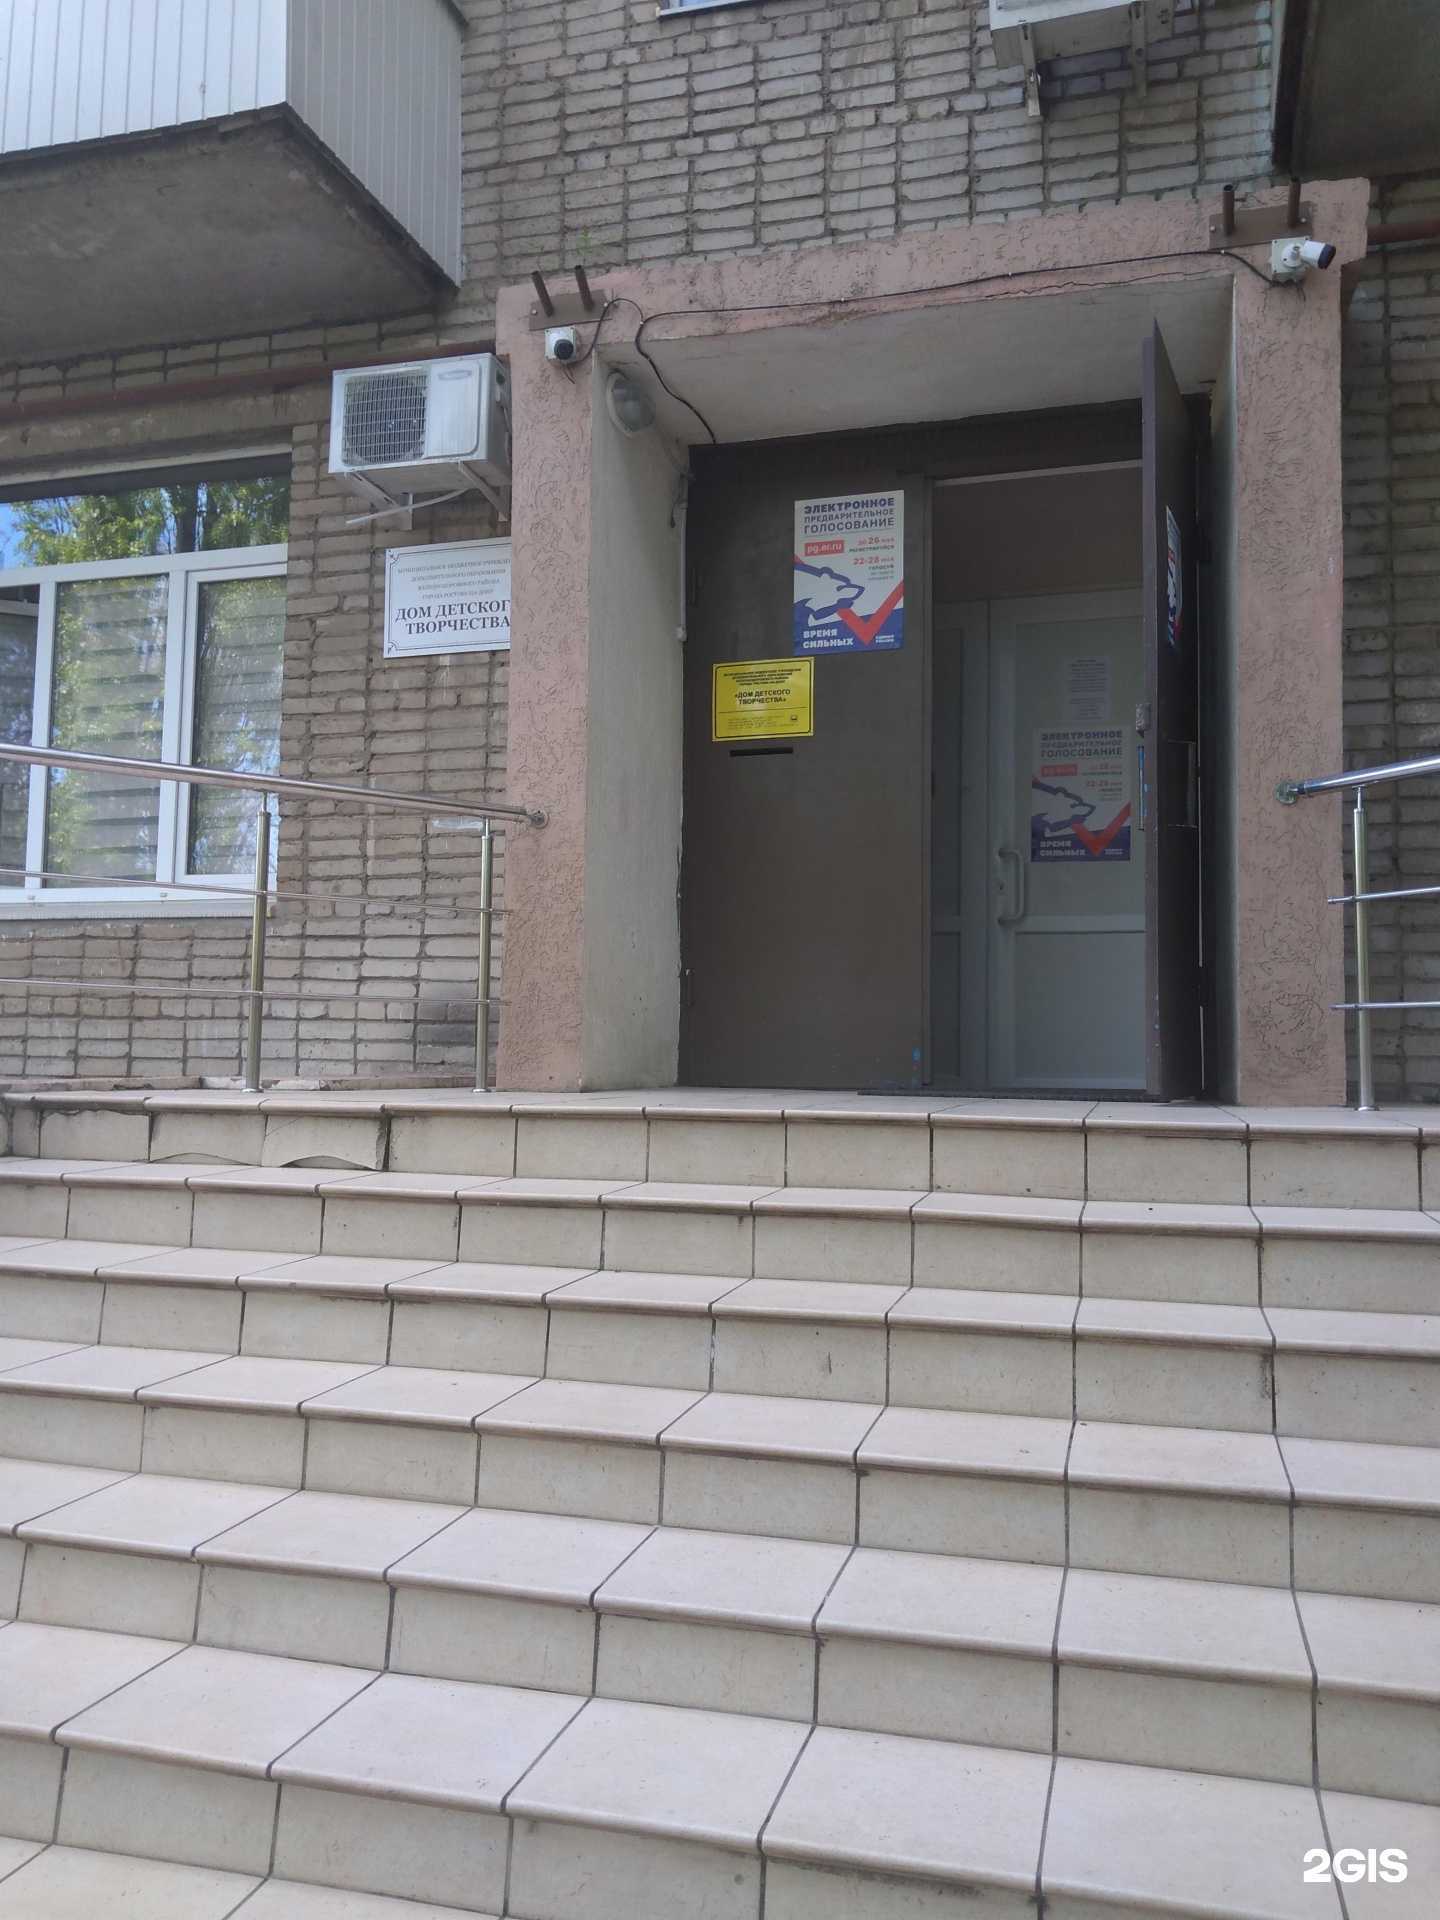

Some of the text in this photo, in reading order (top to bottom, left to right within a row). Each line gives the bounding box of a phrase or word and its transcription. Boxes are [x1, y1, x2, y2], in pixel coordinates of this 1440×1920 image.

[804, 497, 895, 515] ЭЛЕКТРОННОЕ
[804, 508, 894, 524] ПРЕДВАРИТЕЛЬНОЕ
[804, 517, 895, 534] ГОЛОСОВАНИЕ
[395, 600, 511, 623] ДОМ ДЕТСКОГ
[405, 615, 511, 635] ТВОРЧЕСТВА
[803, 629, 838, 639] ВРЕМЯ
[803, 636, 854, 649] СИЛЬНЫХ
[755, 689, 791, 697] ДЕТСКОГО
[1041, 730, 1123, 741] ЭЛЕКТРОННОЕ
[1040, 747, 1123, 758] ГОЛОСОВАНИЕ
